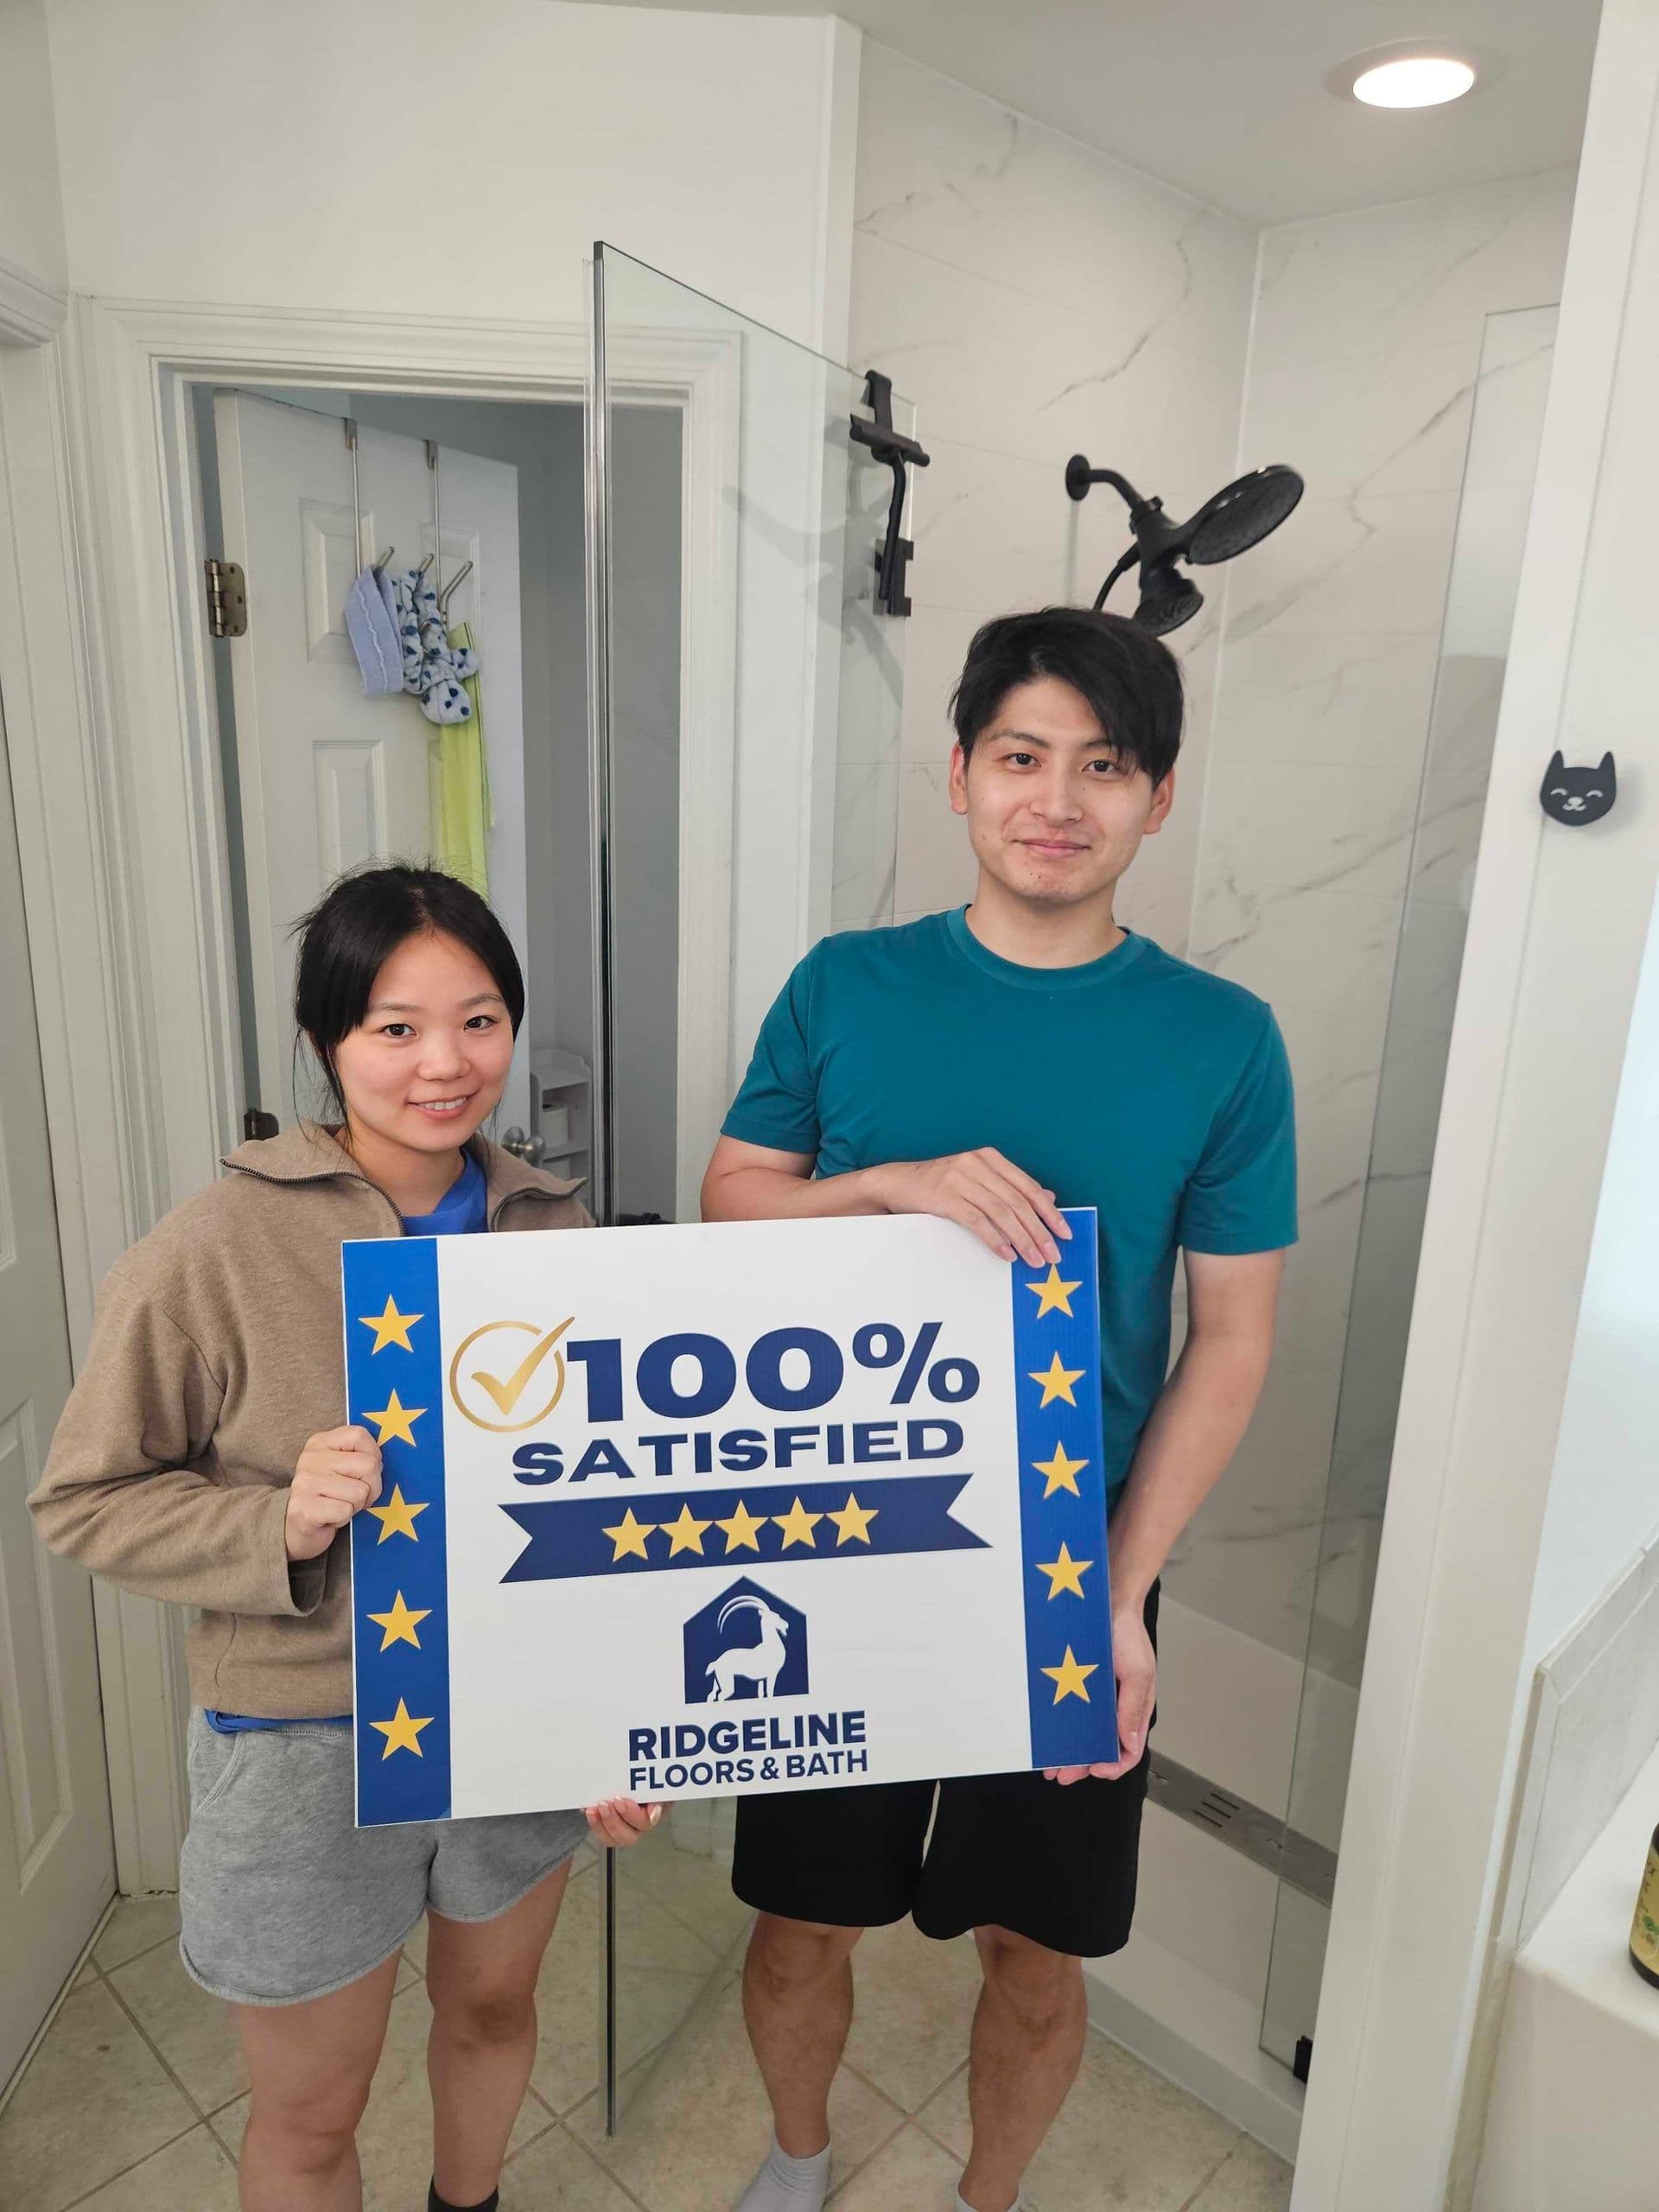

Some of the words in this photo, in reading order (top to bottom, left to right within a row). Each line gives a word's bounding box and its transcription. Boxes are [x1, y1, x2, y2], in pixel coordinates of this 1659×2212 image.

[566, 1321, 980, 1423] 100%
[512, 1419, 964, 1486] SATISFIED
[628, 1710, 867, 1762] RIDGELINE
[629, 1758, 755, 1791] FLOORS
[760, 1756, 780, 1781] &
[786, 1748, 868, 1778] BATH
